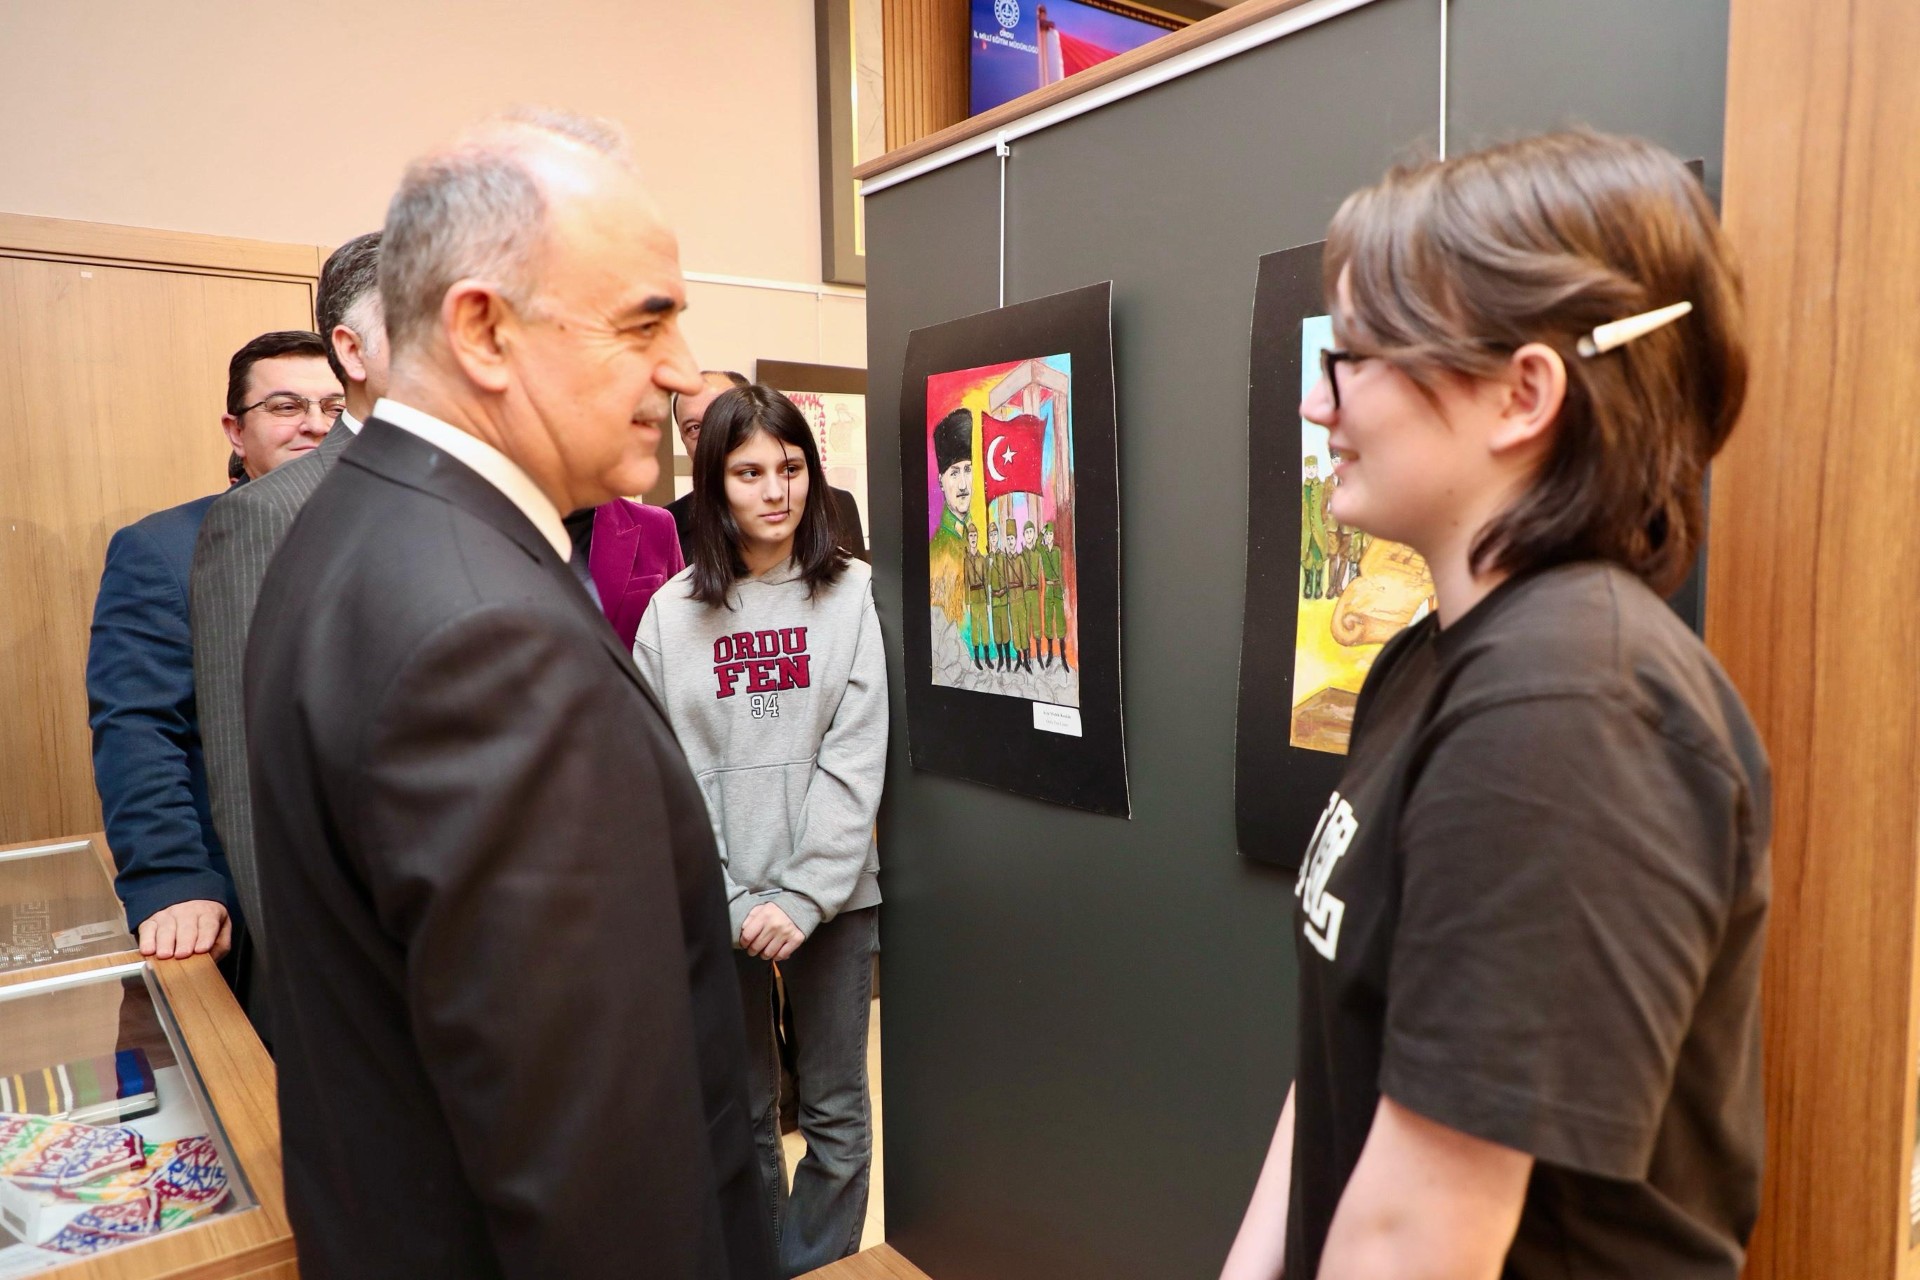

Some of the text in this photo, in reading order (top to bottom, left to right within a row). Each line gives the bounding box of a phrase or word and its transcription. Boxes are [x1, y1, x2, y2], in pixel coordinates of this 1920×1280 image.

[713, 626, 808, 664] ORDU
[713, 654, 811, 699] FEN
[751, 693, 779, 719] 94
